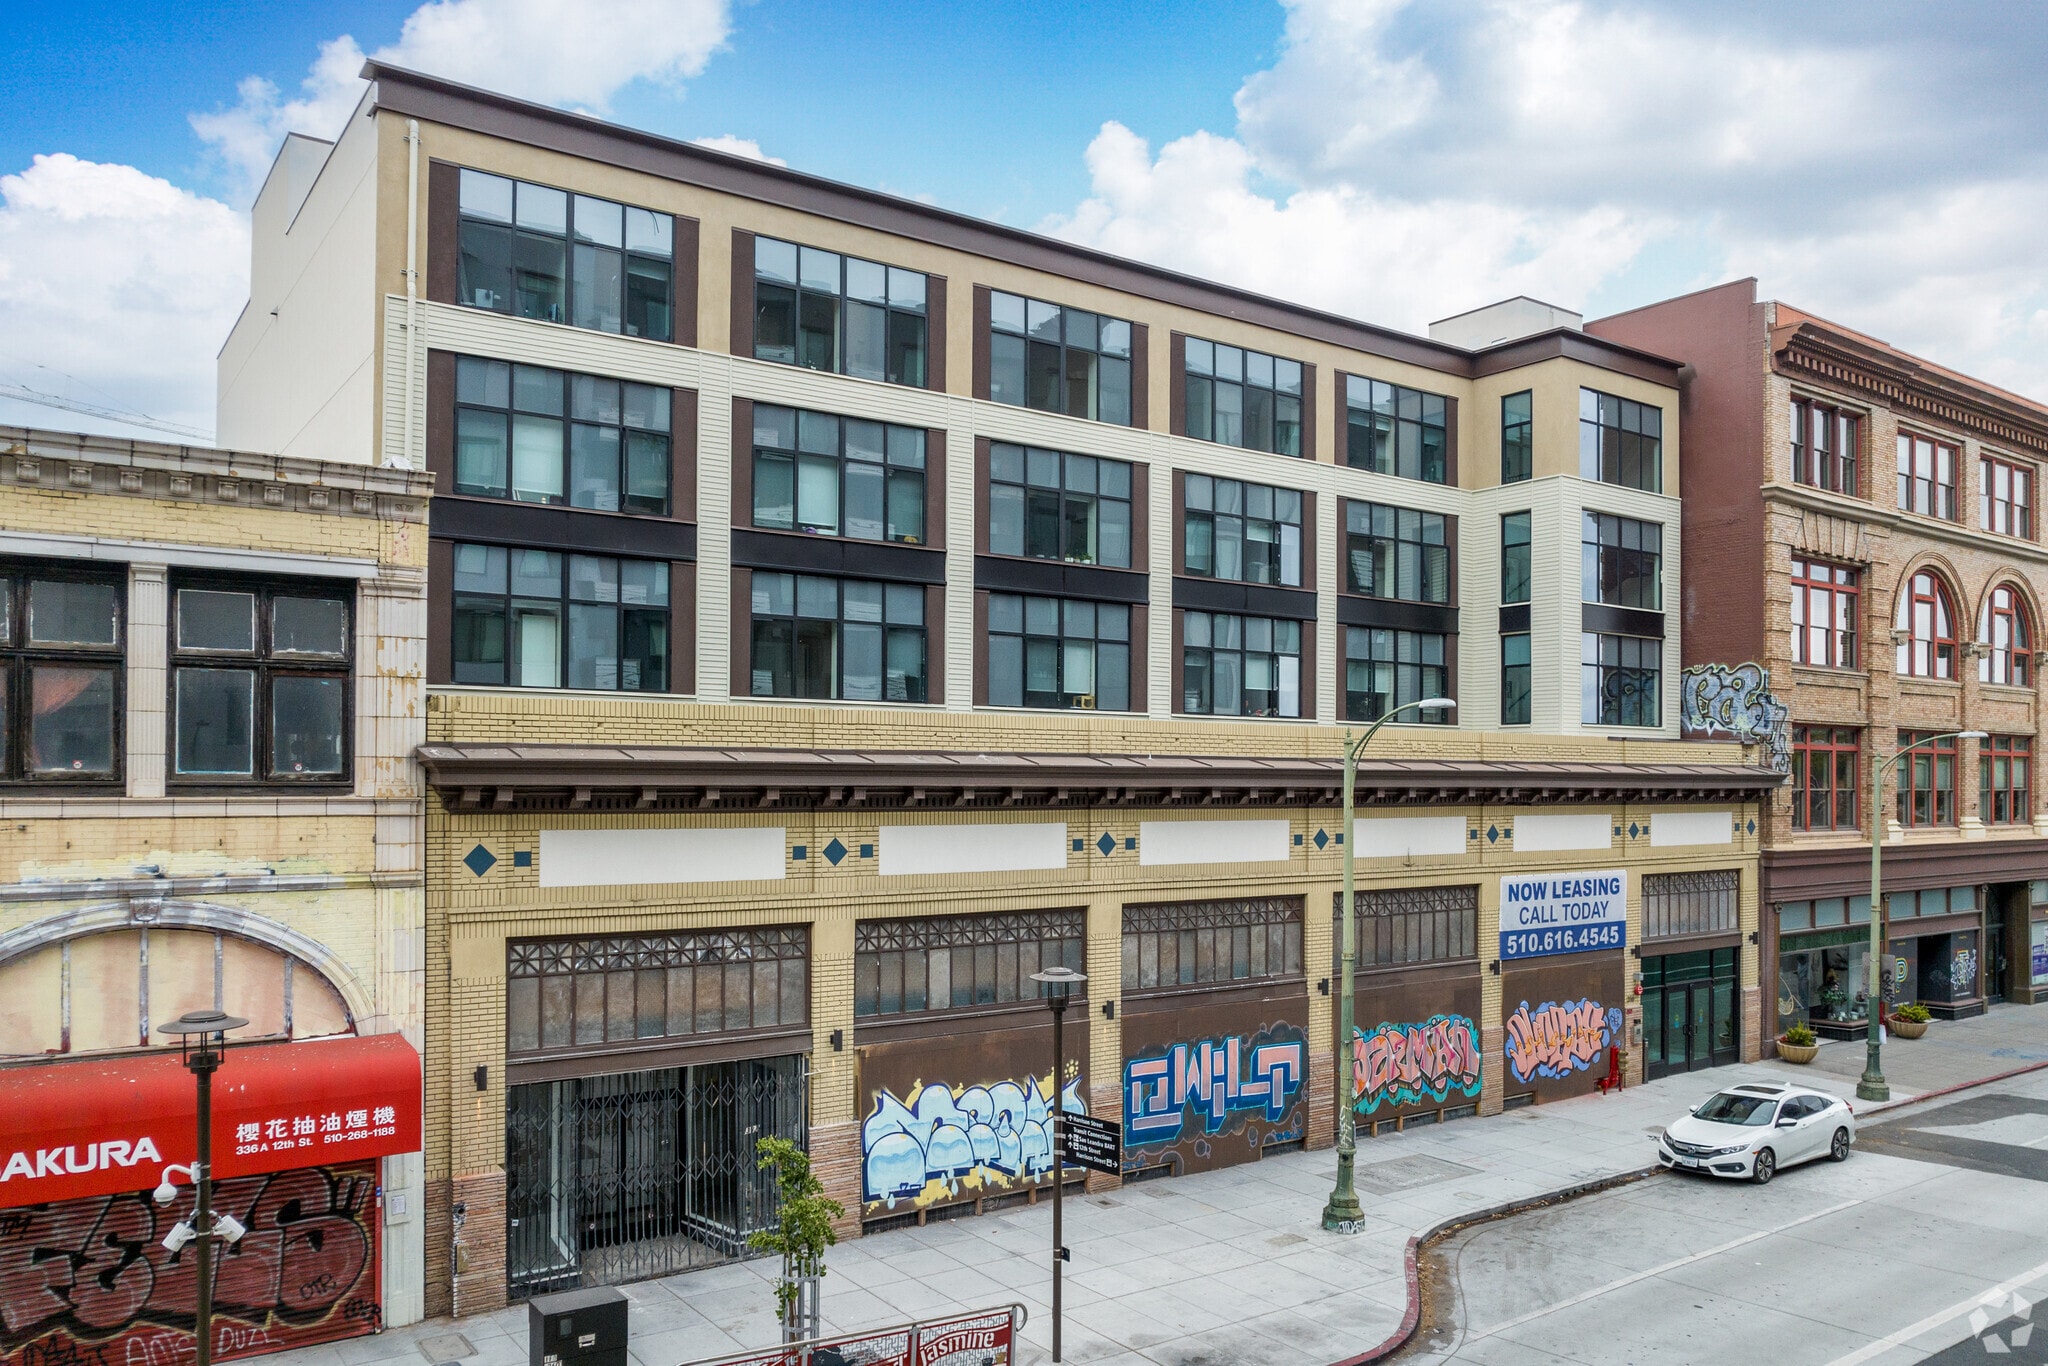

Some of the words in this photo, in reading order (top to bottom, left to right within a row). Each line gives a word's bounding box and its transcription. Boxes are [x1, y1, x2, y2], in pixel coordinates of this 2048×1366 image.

[1508, 882, 1547, 902] NOW
[1552, 878, 1620, 899] LEASING
[1519, 905, 1558, 925] CALL
[1562, 900, 1609, 921] TODAY
[1507, 926, 1619, 955] 510.616.4545
[236, 1106, 396, 1143] 櫻花抽油煙機
[1073, 1126, 1087, 1135] Transit
[1087, 1130, 1113, 1142] Connections
[1090, 1120, 1104, 1129] Street
[272, 1139, 295, 1151] 12th
[298, 1137, 313, 1147] St.
[324, 1126, 396, 1144] 510-268-1188
[1088, 1146, 1101, 1155] Street
[1104, 1142, 1116, 1150] BART
[0, 1137, 162, 1183] AKURA
[1093, 1156, 1107, 1165] Street
